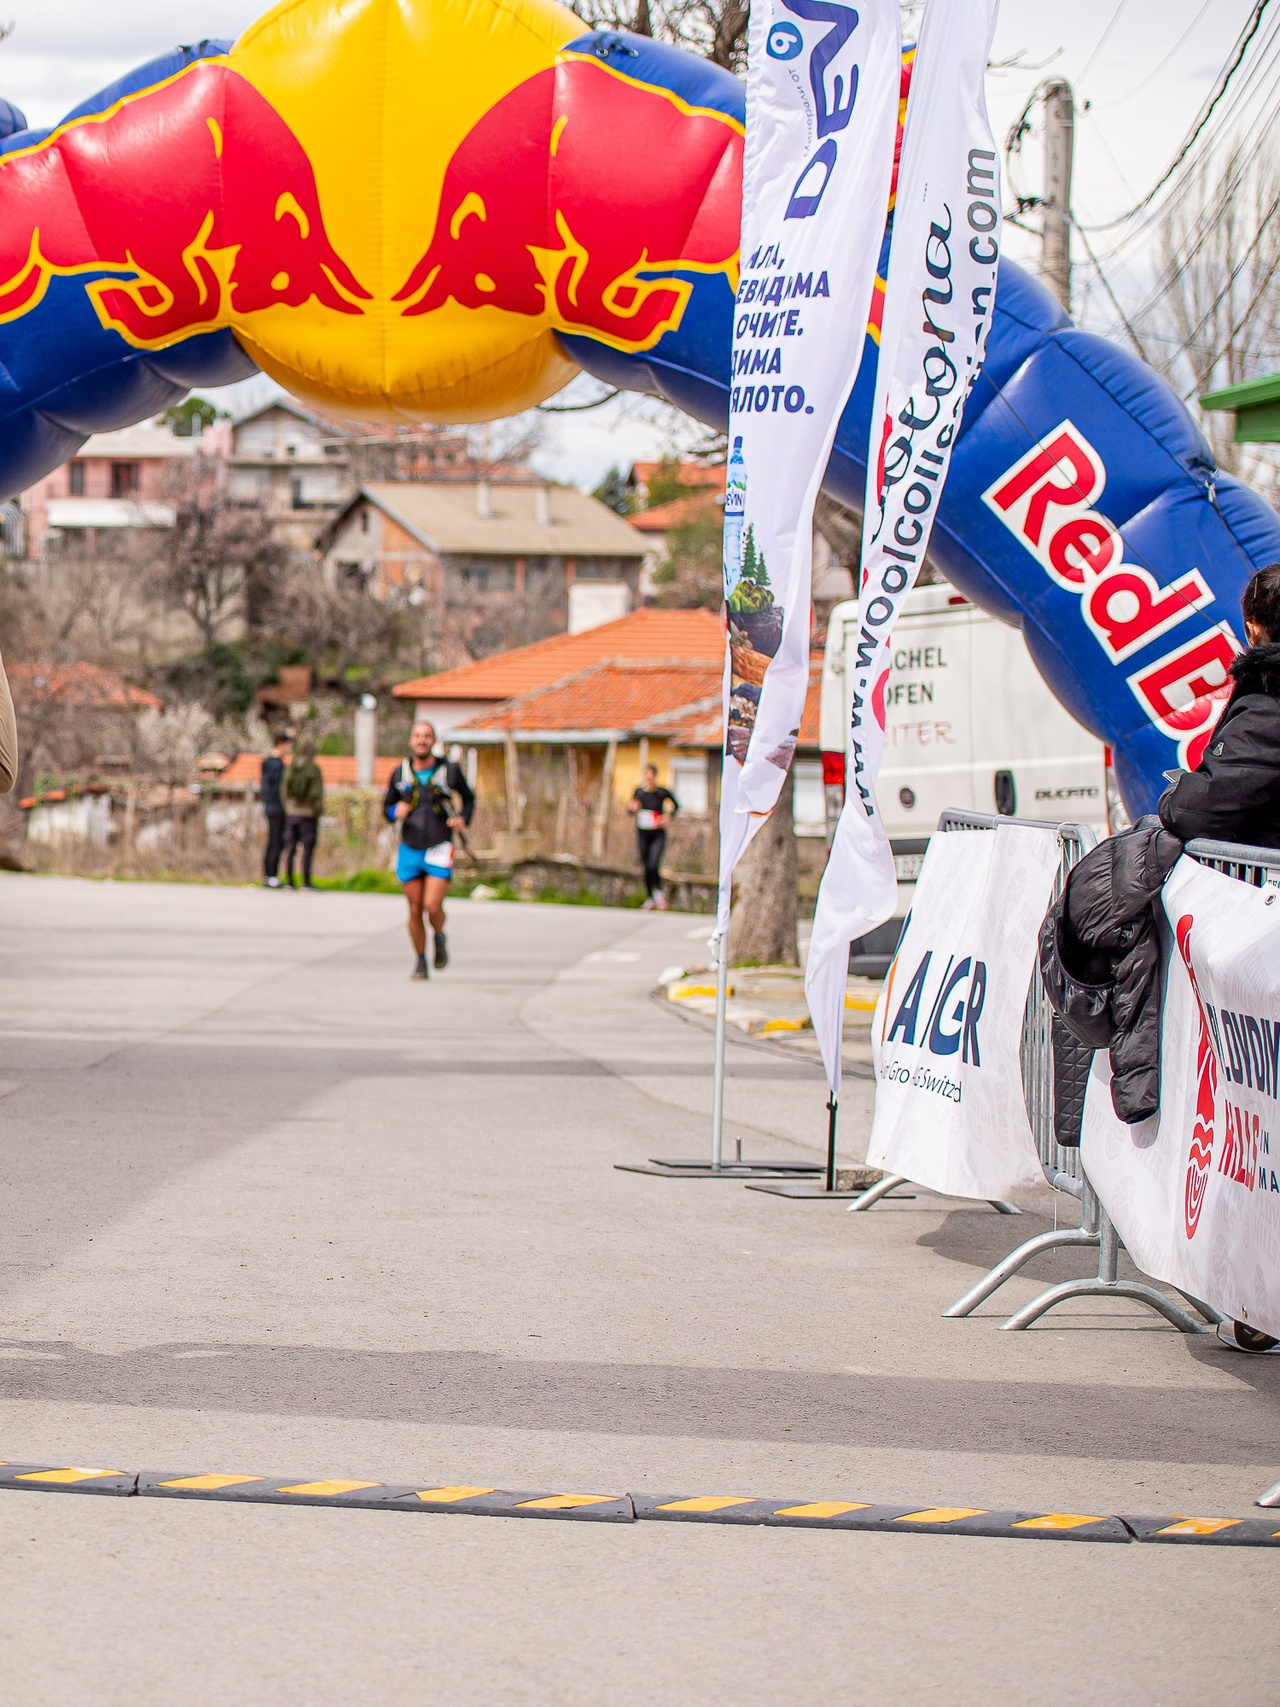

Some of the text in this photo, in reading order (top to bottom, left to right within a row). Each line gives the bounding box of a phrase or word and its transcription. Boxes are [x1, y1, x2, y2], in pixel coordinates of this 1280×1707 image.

[981, 418, 1216, 667] Red
[889, 647, 948, 671] CHEL
[1034, 787, 1099, 800] DUCATO
[1260, 1129, 1270, 1155] IN
